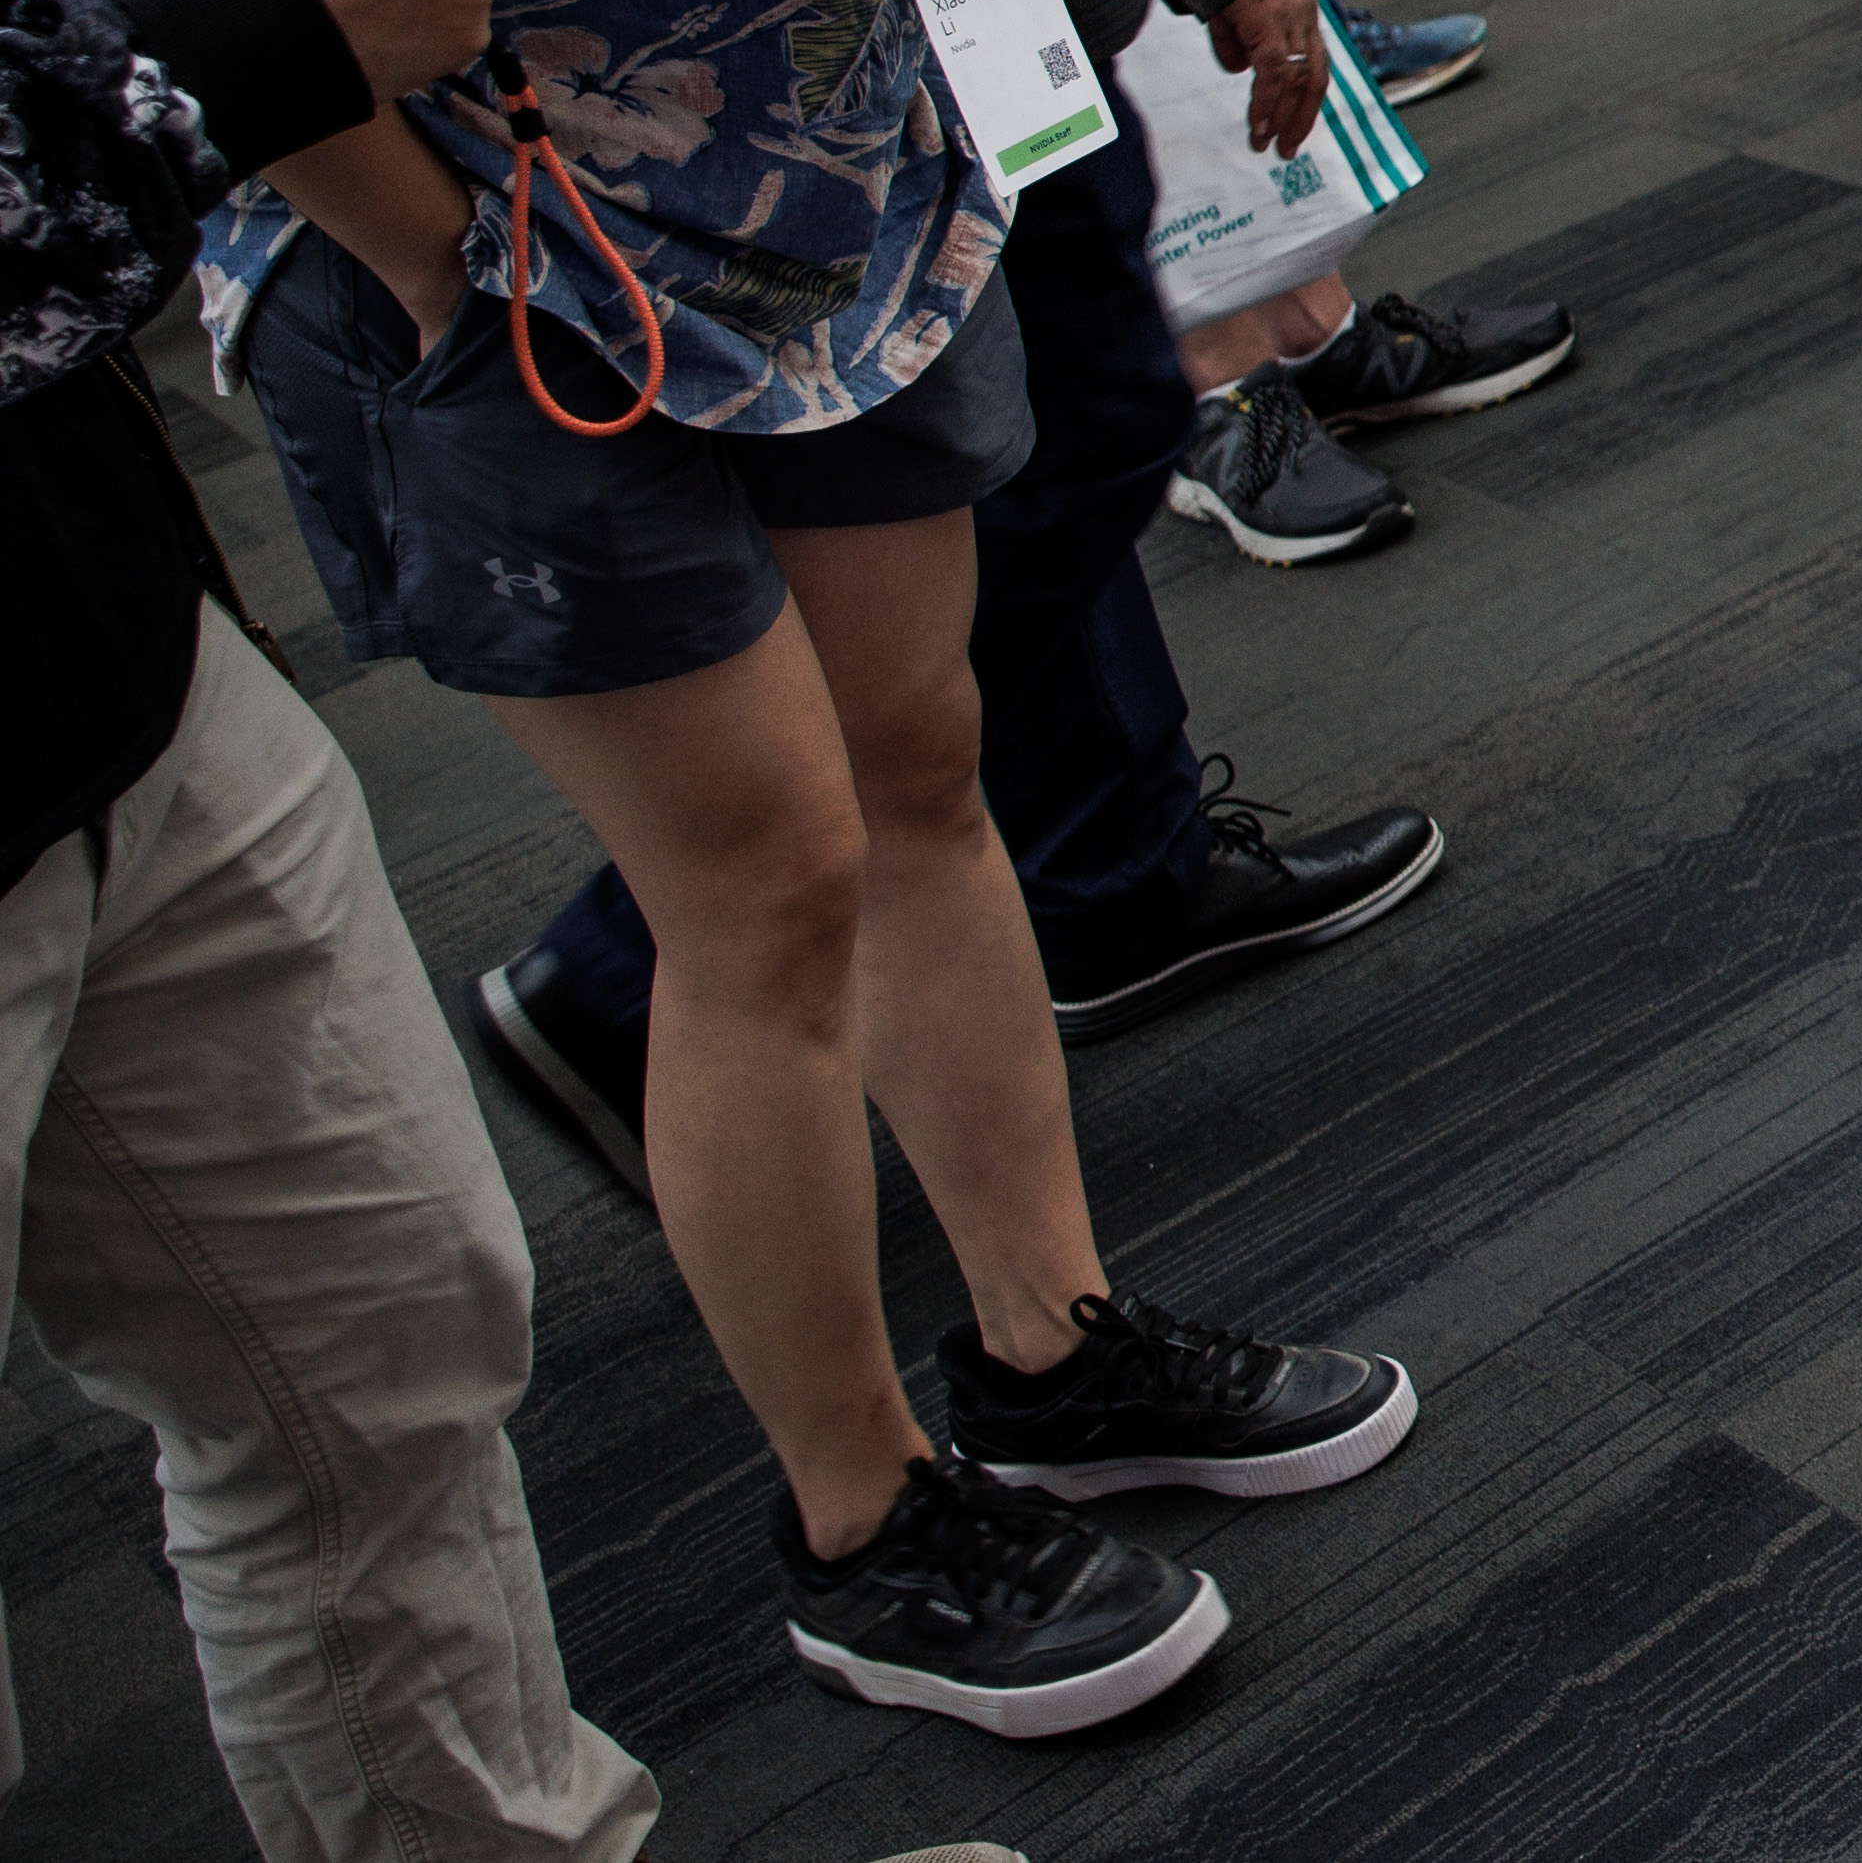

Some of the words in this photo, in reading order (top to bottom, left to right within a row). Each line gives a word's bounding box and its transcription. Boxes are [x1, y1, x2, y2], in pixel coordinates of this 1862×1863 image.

[940, 17, 957, 36] Li
[950, 38, 977, 55] Nvidia
[1029, 136, 1056, 153] NVIDIA
[1054, 125, 1072, 142] Staff
[1196, 209, 1256, 247] Power
